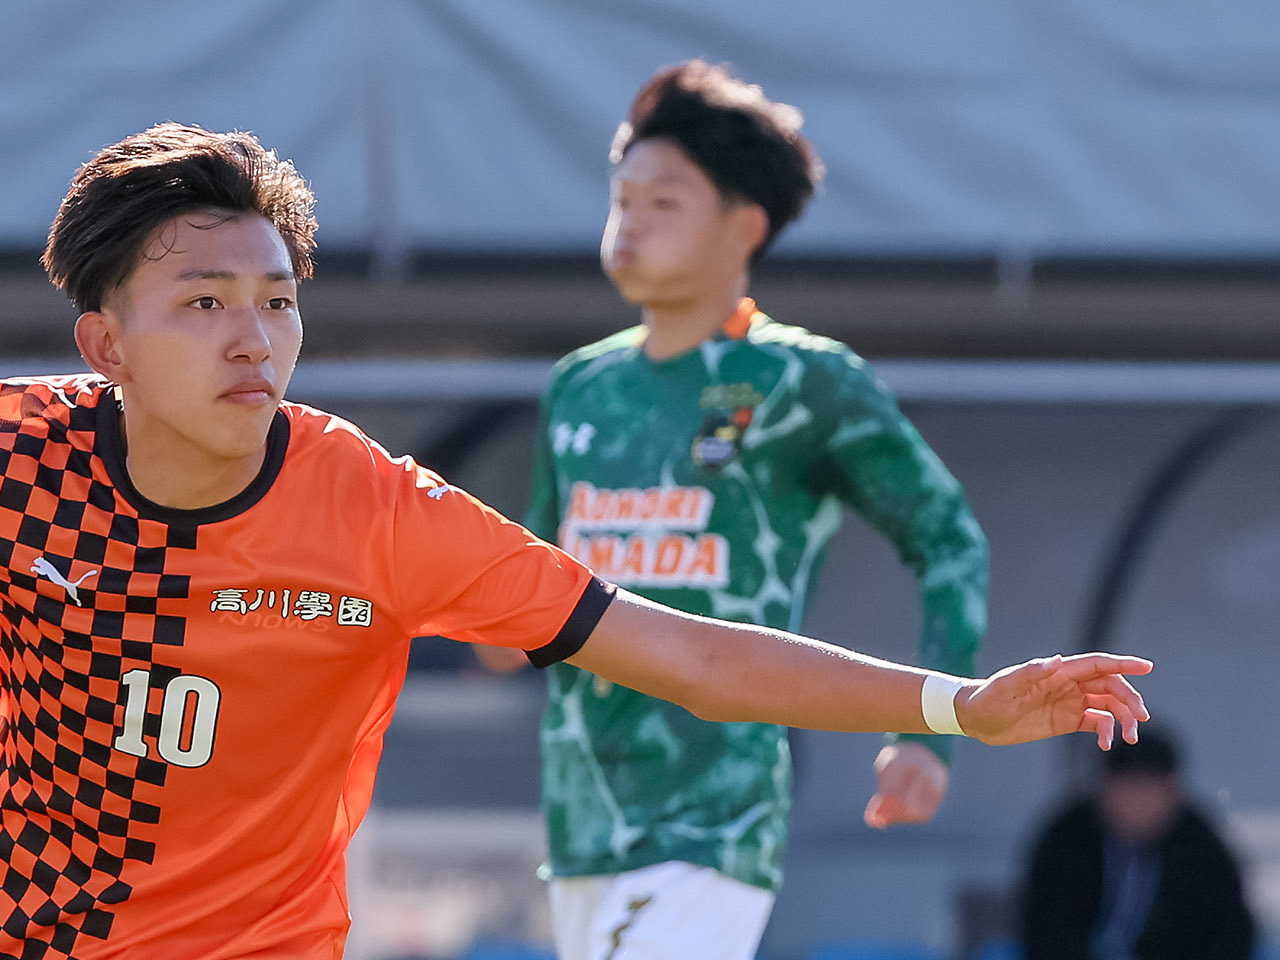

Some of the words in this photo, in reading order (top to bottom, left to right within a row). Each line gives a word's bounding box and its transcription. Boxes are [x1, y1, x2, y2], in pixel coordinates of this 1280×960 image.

[210, 588, 373, 627] 高川學園
[114, 669, 221, 768] 10
